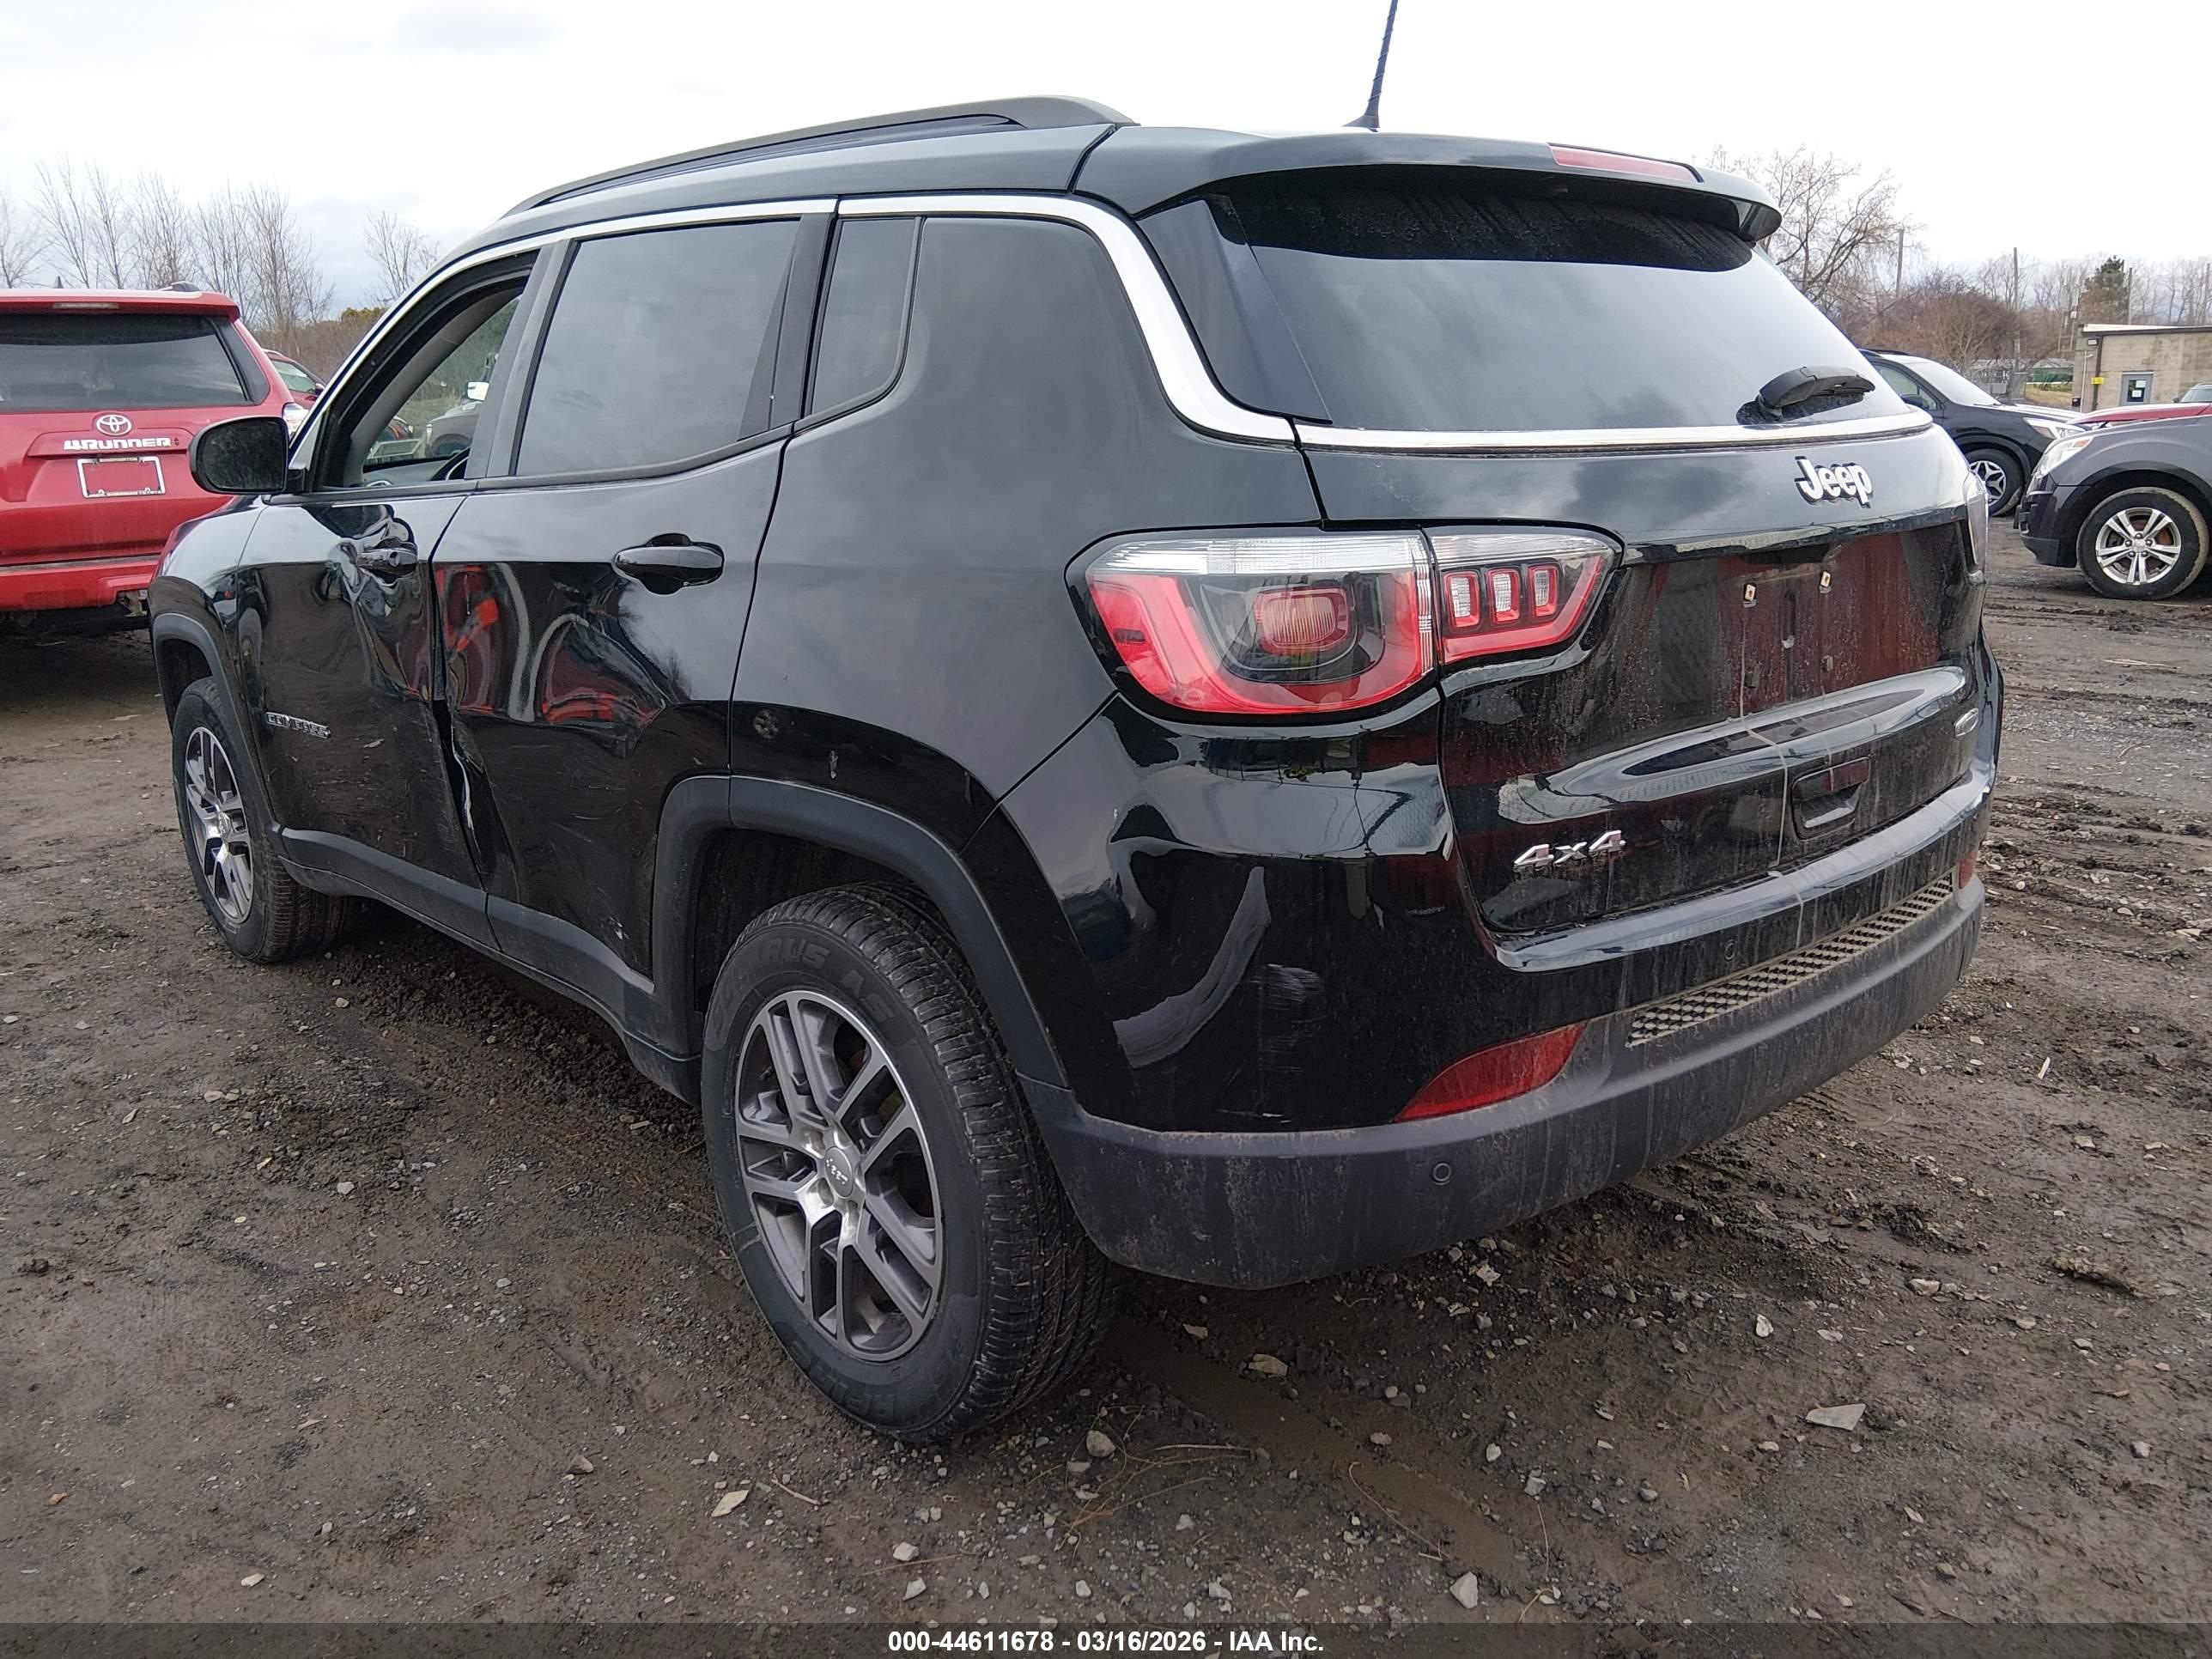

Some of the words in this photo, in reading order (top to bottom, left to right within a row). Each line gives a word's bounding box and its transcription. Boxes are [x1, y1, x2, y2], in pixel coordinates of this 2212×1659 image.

[64, 437, 172, 450] 4RUNNER
[1794, 455, 1873, 508] Jeep
[1514, 830, 1626, 867] 4x4
